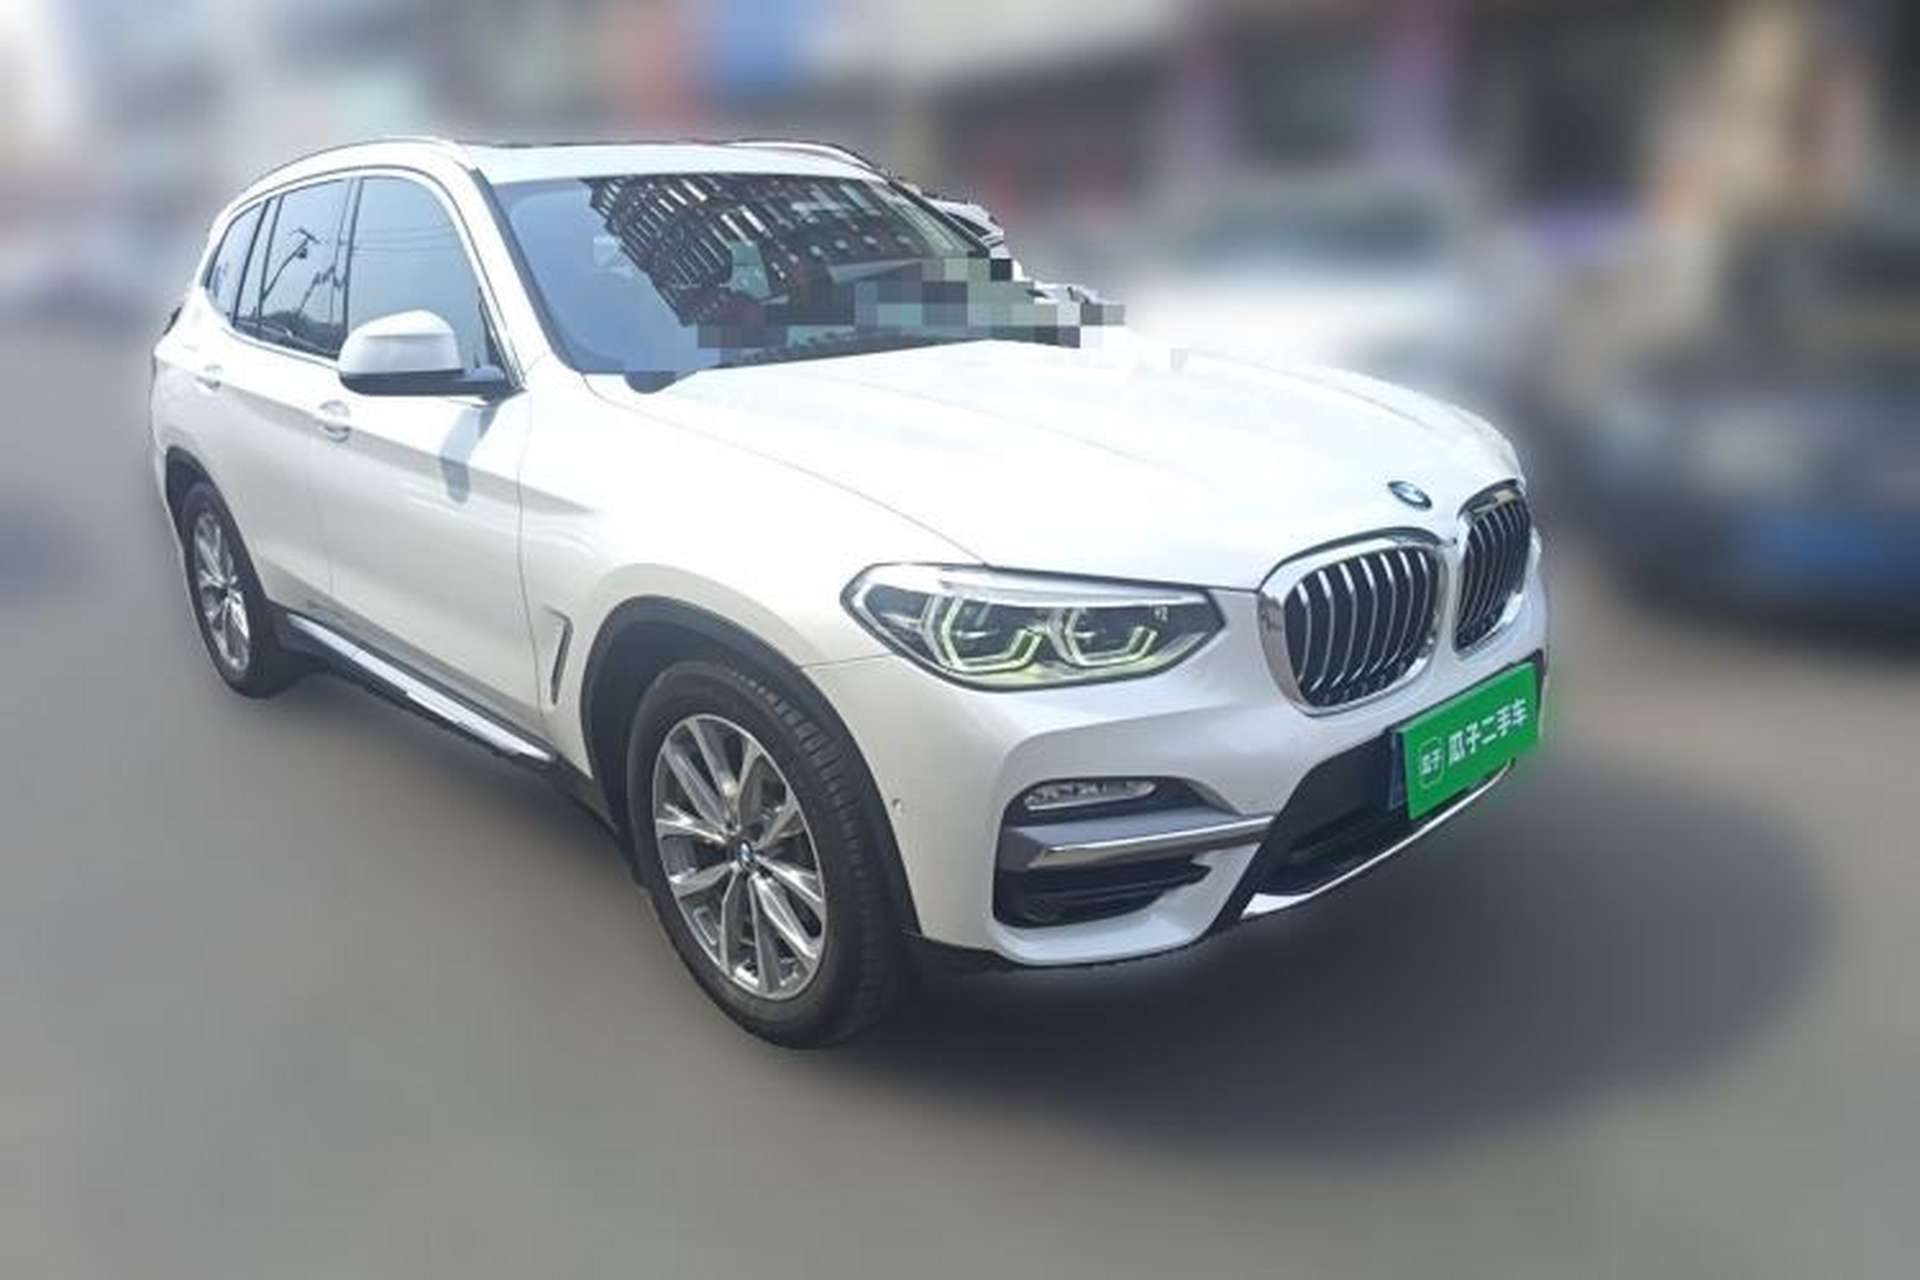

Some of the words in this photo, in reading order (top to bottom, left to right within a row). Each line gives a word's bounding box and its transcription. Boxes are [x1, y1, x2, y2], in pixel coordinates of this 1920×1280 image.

[1448, 698, 1527, 767] 瓜子二手车
